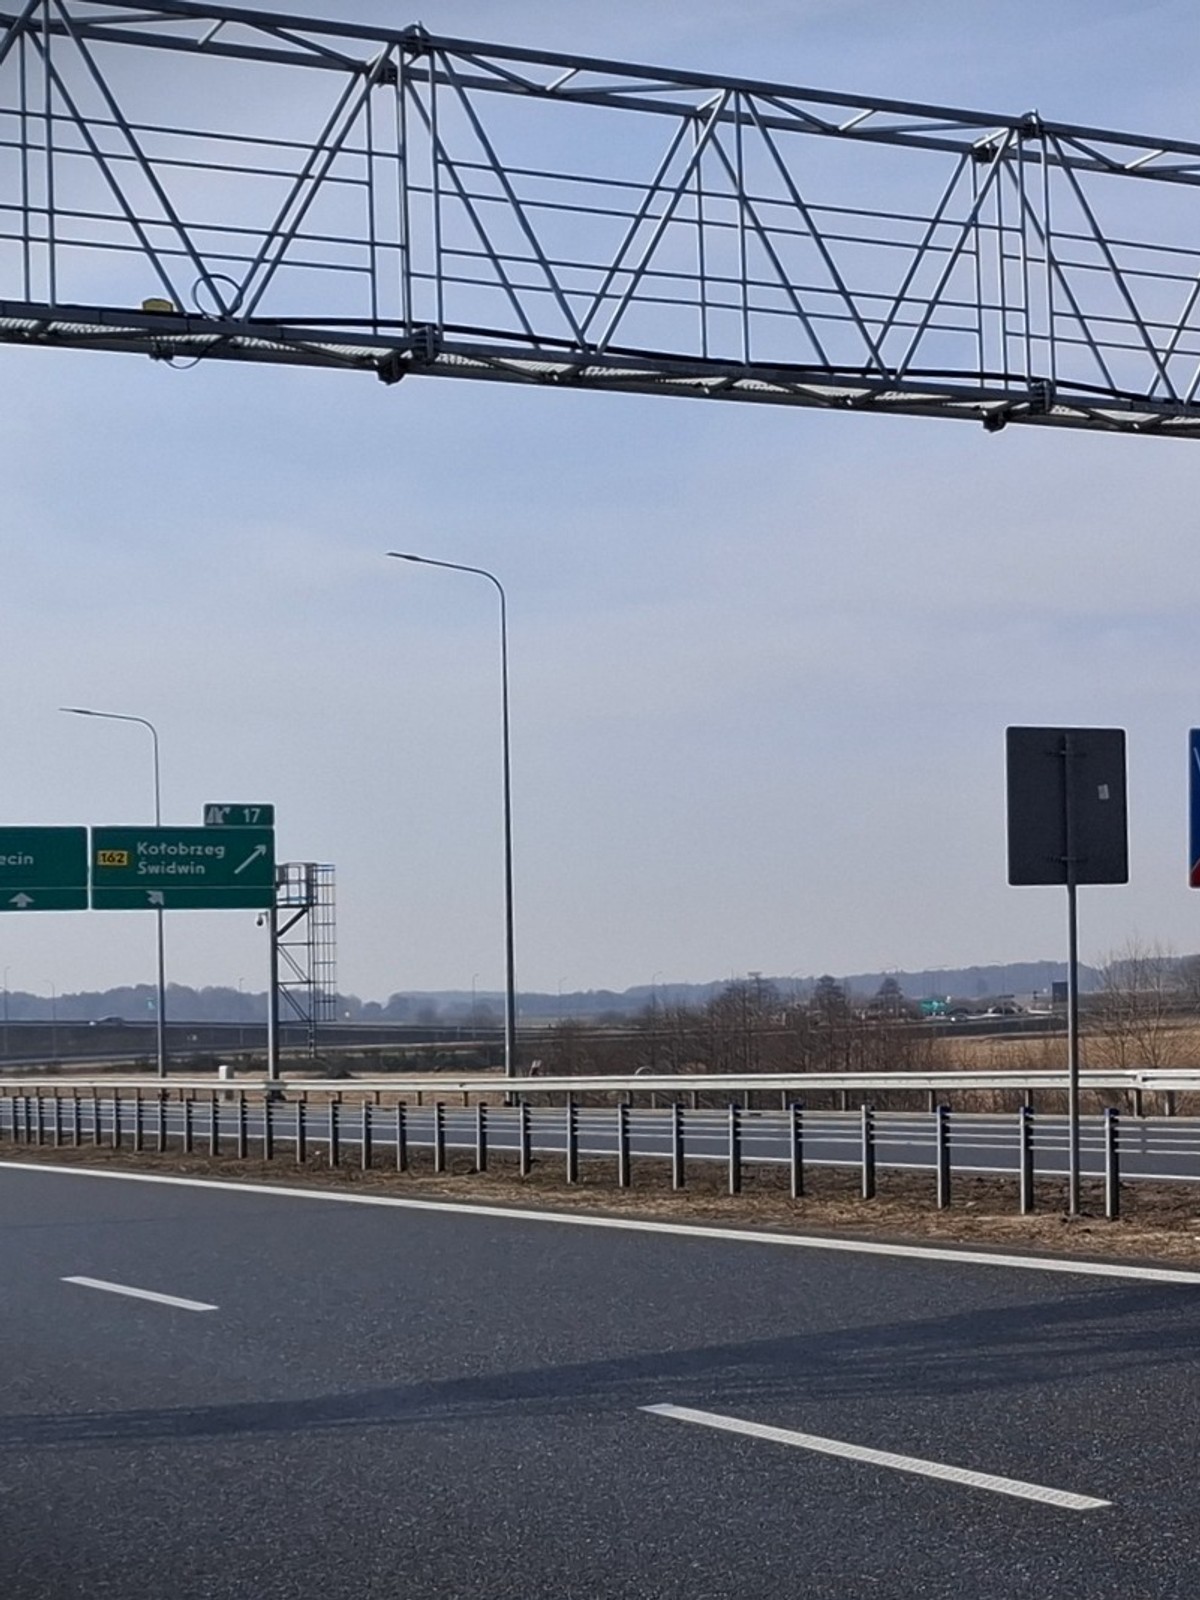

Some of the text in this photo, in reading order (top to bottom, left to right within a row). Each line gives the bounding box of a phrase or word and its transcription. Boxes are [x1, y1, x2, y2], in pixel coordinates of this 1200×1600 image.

[243, 807, 261, 823] 17
[101, 852, 125, 864] 162
[136, 841, 225, 859] Kołobrzeg
[136, 858, 206, 875] Świdwin
